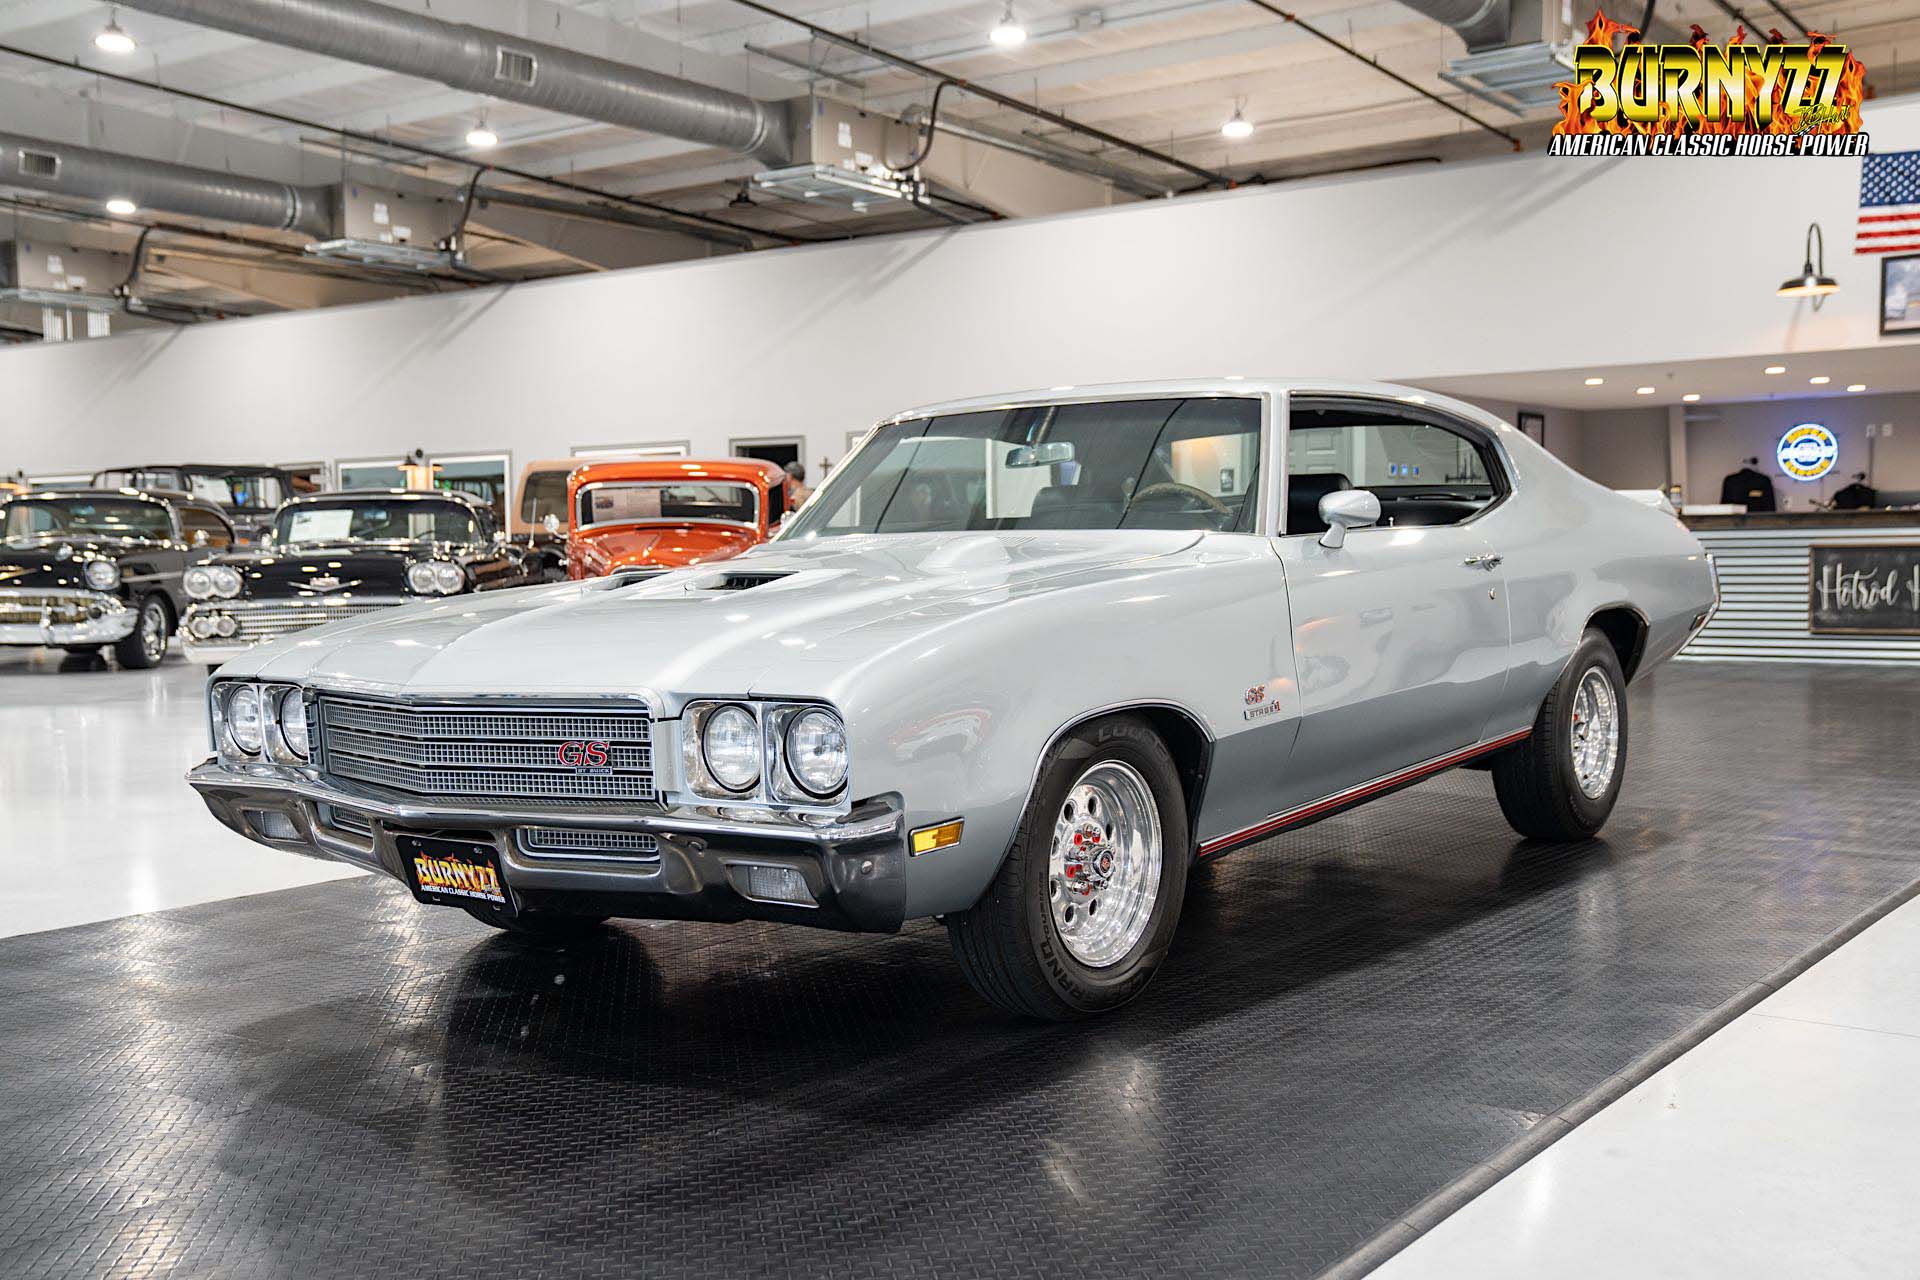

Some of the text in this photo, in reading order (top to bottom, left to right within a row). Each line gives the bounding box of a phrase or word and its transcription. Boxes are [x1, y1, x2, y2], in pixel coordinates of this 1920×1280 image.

[558, 741, 609, 767] GS
[421, 884, 449, 894] AMERICAN
[487, 893, 506, 903] POWER
